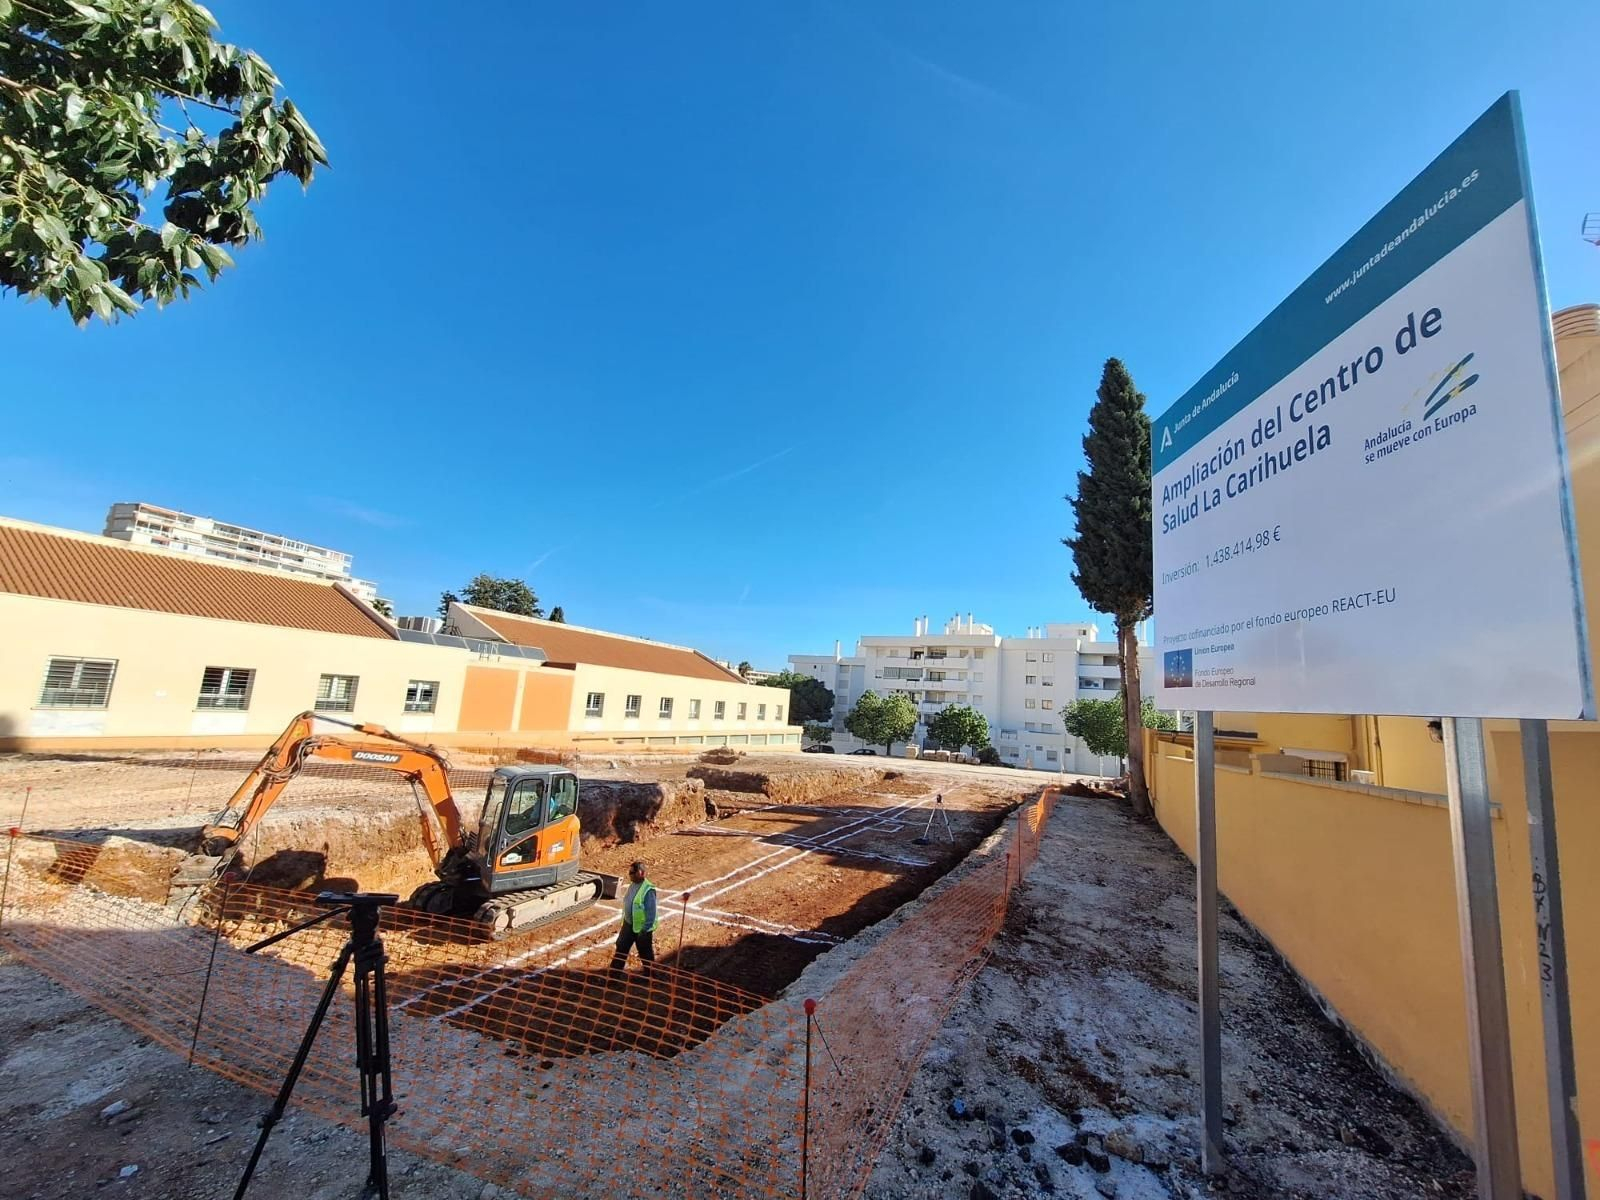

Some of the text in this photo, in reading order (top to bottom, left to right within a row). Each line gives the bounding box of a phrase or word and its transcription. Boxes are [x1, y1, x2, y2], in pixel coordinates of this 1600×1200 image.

[1325, 168, 1480, 305] www.juntadeandalucia.es
[1162, 307, 1442, 507] Ampliación del Centro de
[1173, 371, 1240, 434] Junta de Andalucía
[1364, 419, 1412, 451] Andalucía
[1365, 404, 1477, 464] se mueve con Europa
[1162, 424, 1331, 535] Salud La Carihuela
[1162, 525, 1281, 585] Inversión: 1.438.414,98 €
[1188, 624, 1230, 641] cofinanciado
[1231, 622, 1245, 635] por
[1246, 617, 1254, 629] el
[1255, 612, 1282, 627] fondo
[1284, 604, 1329, 622] europeo
[1332, 587, 1397, 613] REACT-EU
[1194, 667, 1235, 677] Fondo Europeo
[1210, 642, 1235, 654] Europea
[1202, 679, 1229, 688] Desarrollo
[1229, 677, 1256, 688] Regional
[354, 751, 399, 762] DOOSAN
